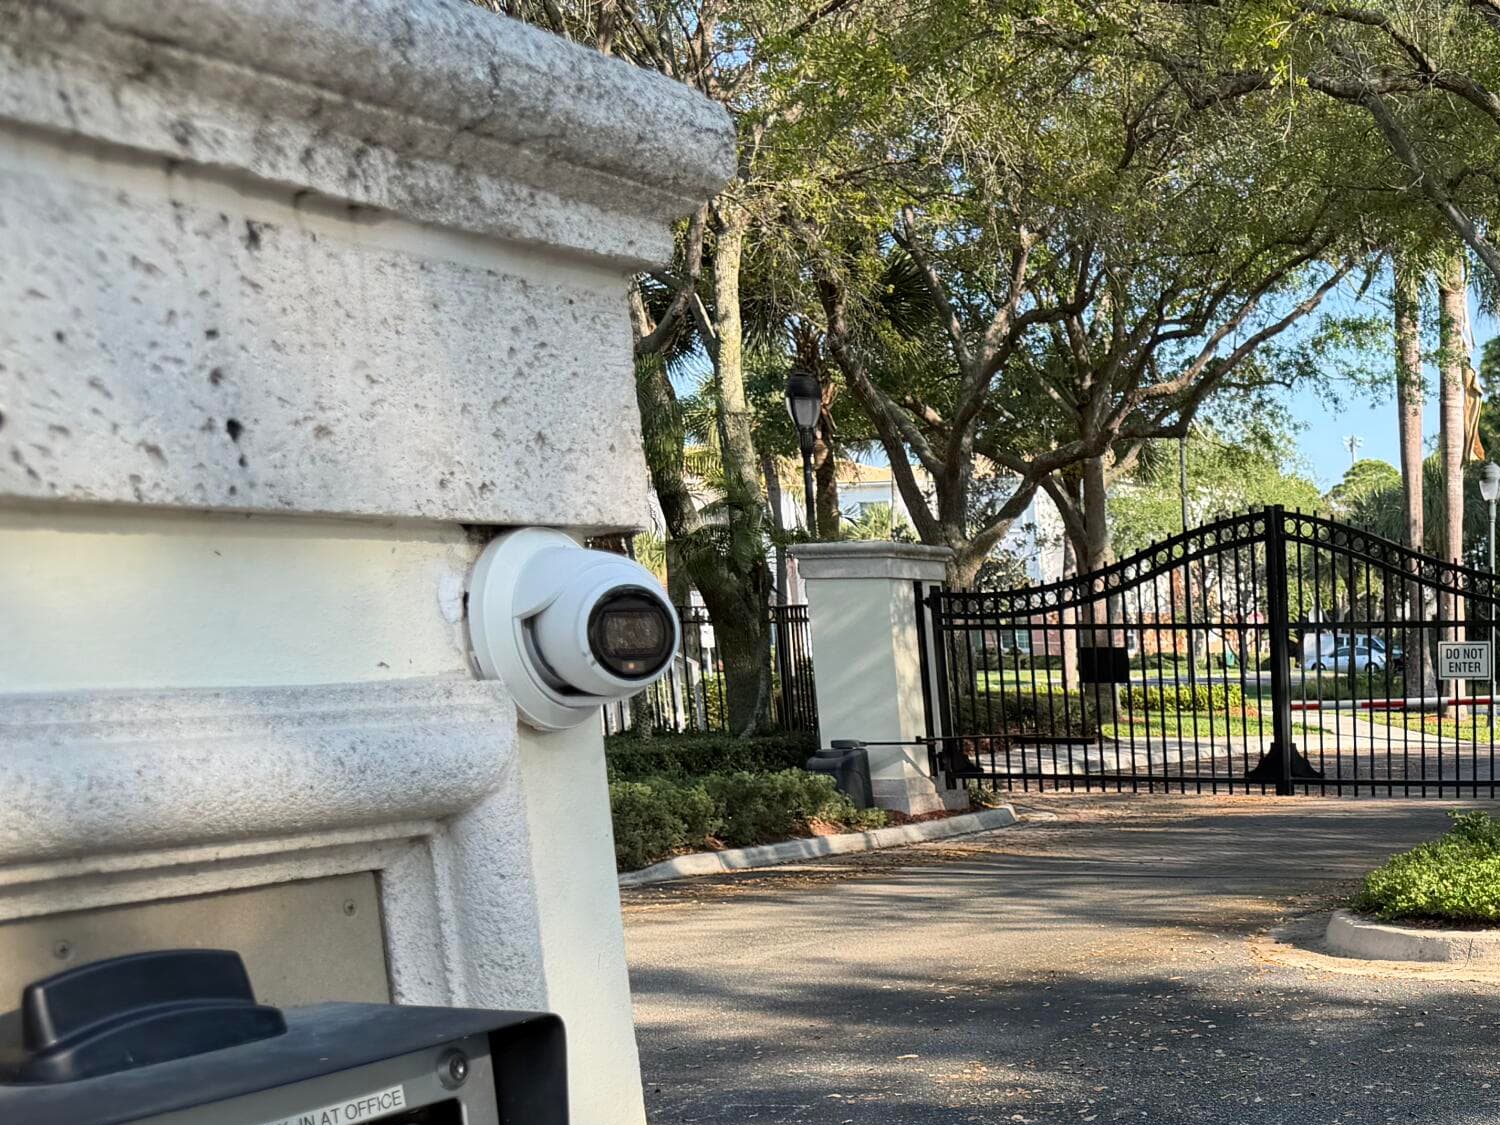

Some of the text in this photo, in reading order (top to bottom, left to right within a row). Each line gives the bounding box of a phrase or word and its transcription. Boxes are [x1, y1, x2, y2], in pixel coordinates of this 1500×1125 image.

[1446, 648, 1484, 660] DO NOT
[1449, 662, 1481, 672] ENTER
[345, 1090, 403, 1121] OFFICE
